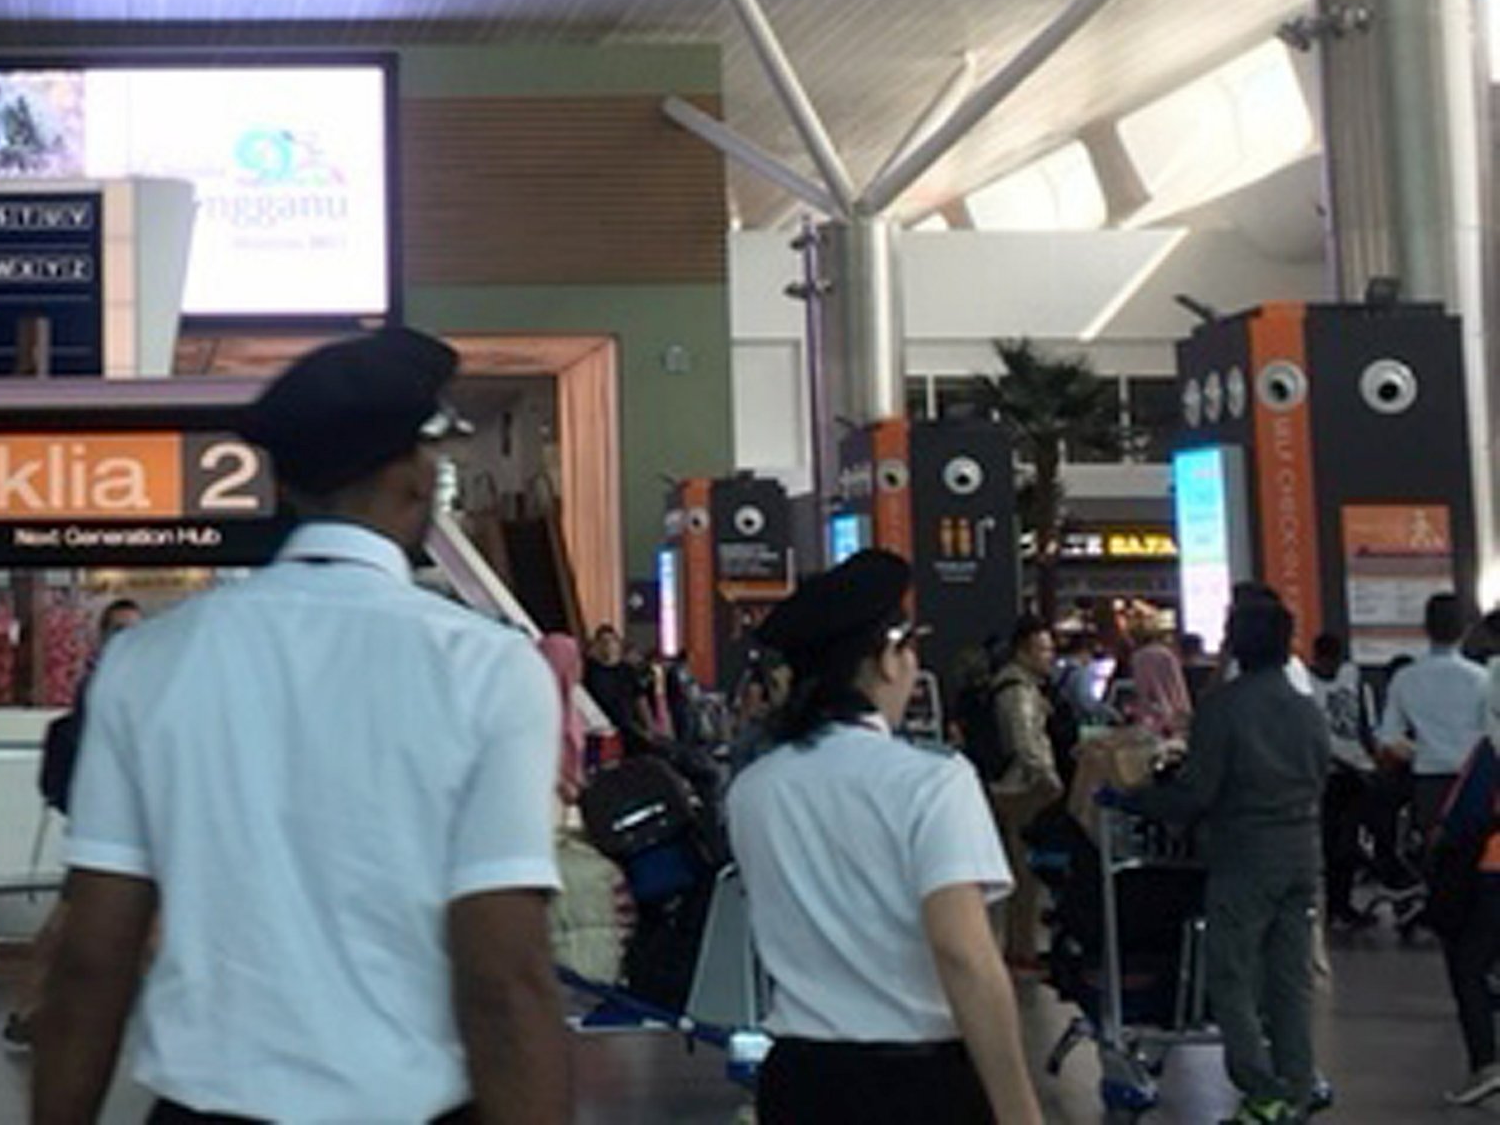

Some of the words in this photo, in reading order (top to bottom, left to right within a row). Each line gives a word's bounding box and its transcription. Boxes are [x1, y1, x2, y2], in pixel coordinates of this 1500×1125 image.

[199, 442, 260, 510] 2
[13, 528, 61, 546] Next
[64, 528, 175, 546] Generation
[177, 528, 222, 546] Hub
